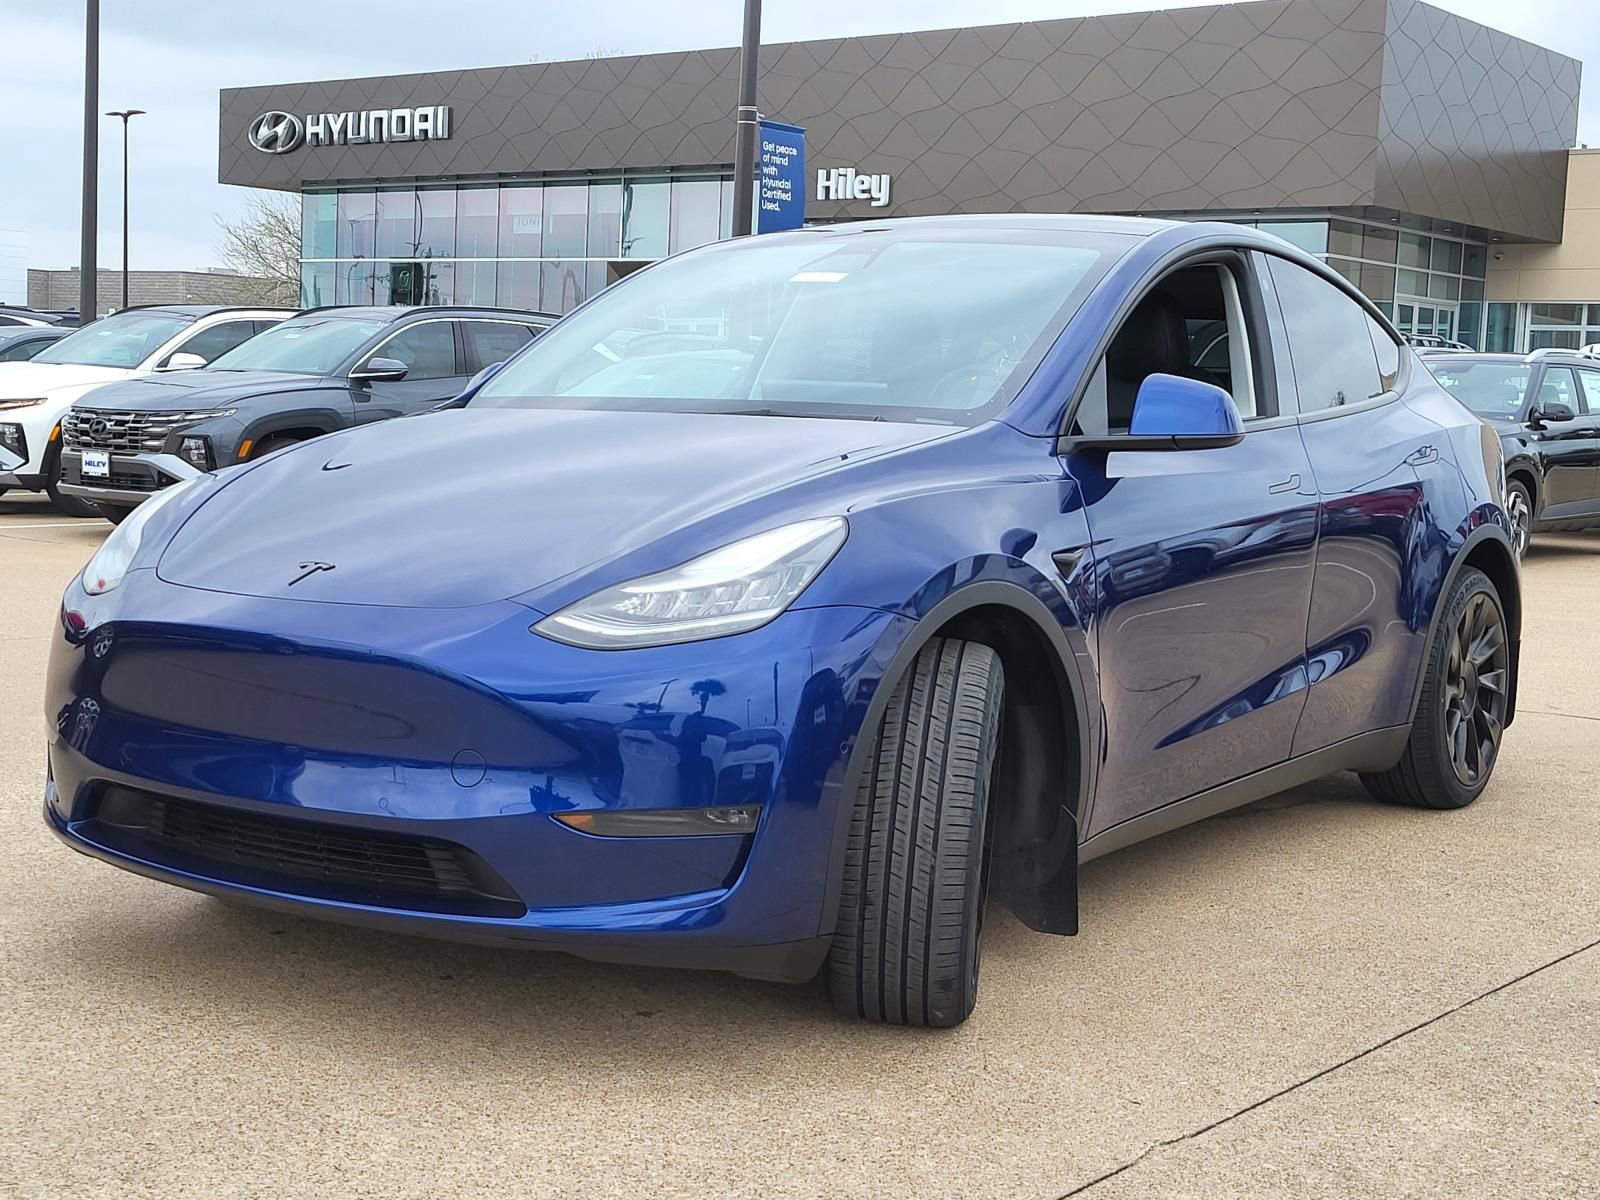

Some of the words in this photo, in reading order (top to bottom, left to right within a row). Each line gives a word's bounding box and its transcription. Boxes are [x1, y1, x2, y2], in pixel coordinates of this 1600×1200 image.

[306, 106, 449, 145] HYUNDAI
[762, 141, 775, 151] Get
[776, 144, 798, 156] peace
[762, 153, 770, 162] of
[771, 155, 788, 166] mind
[762, 166, 778, 176] with
[762, 176, 792, 190] Hyundai
[816, 167, 890, 207] Hiley
[762, 188, 792, 202] Certified
[761, 200, 780, 212] Used.
